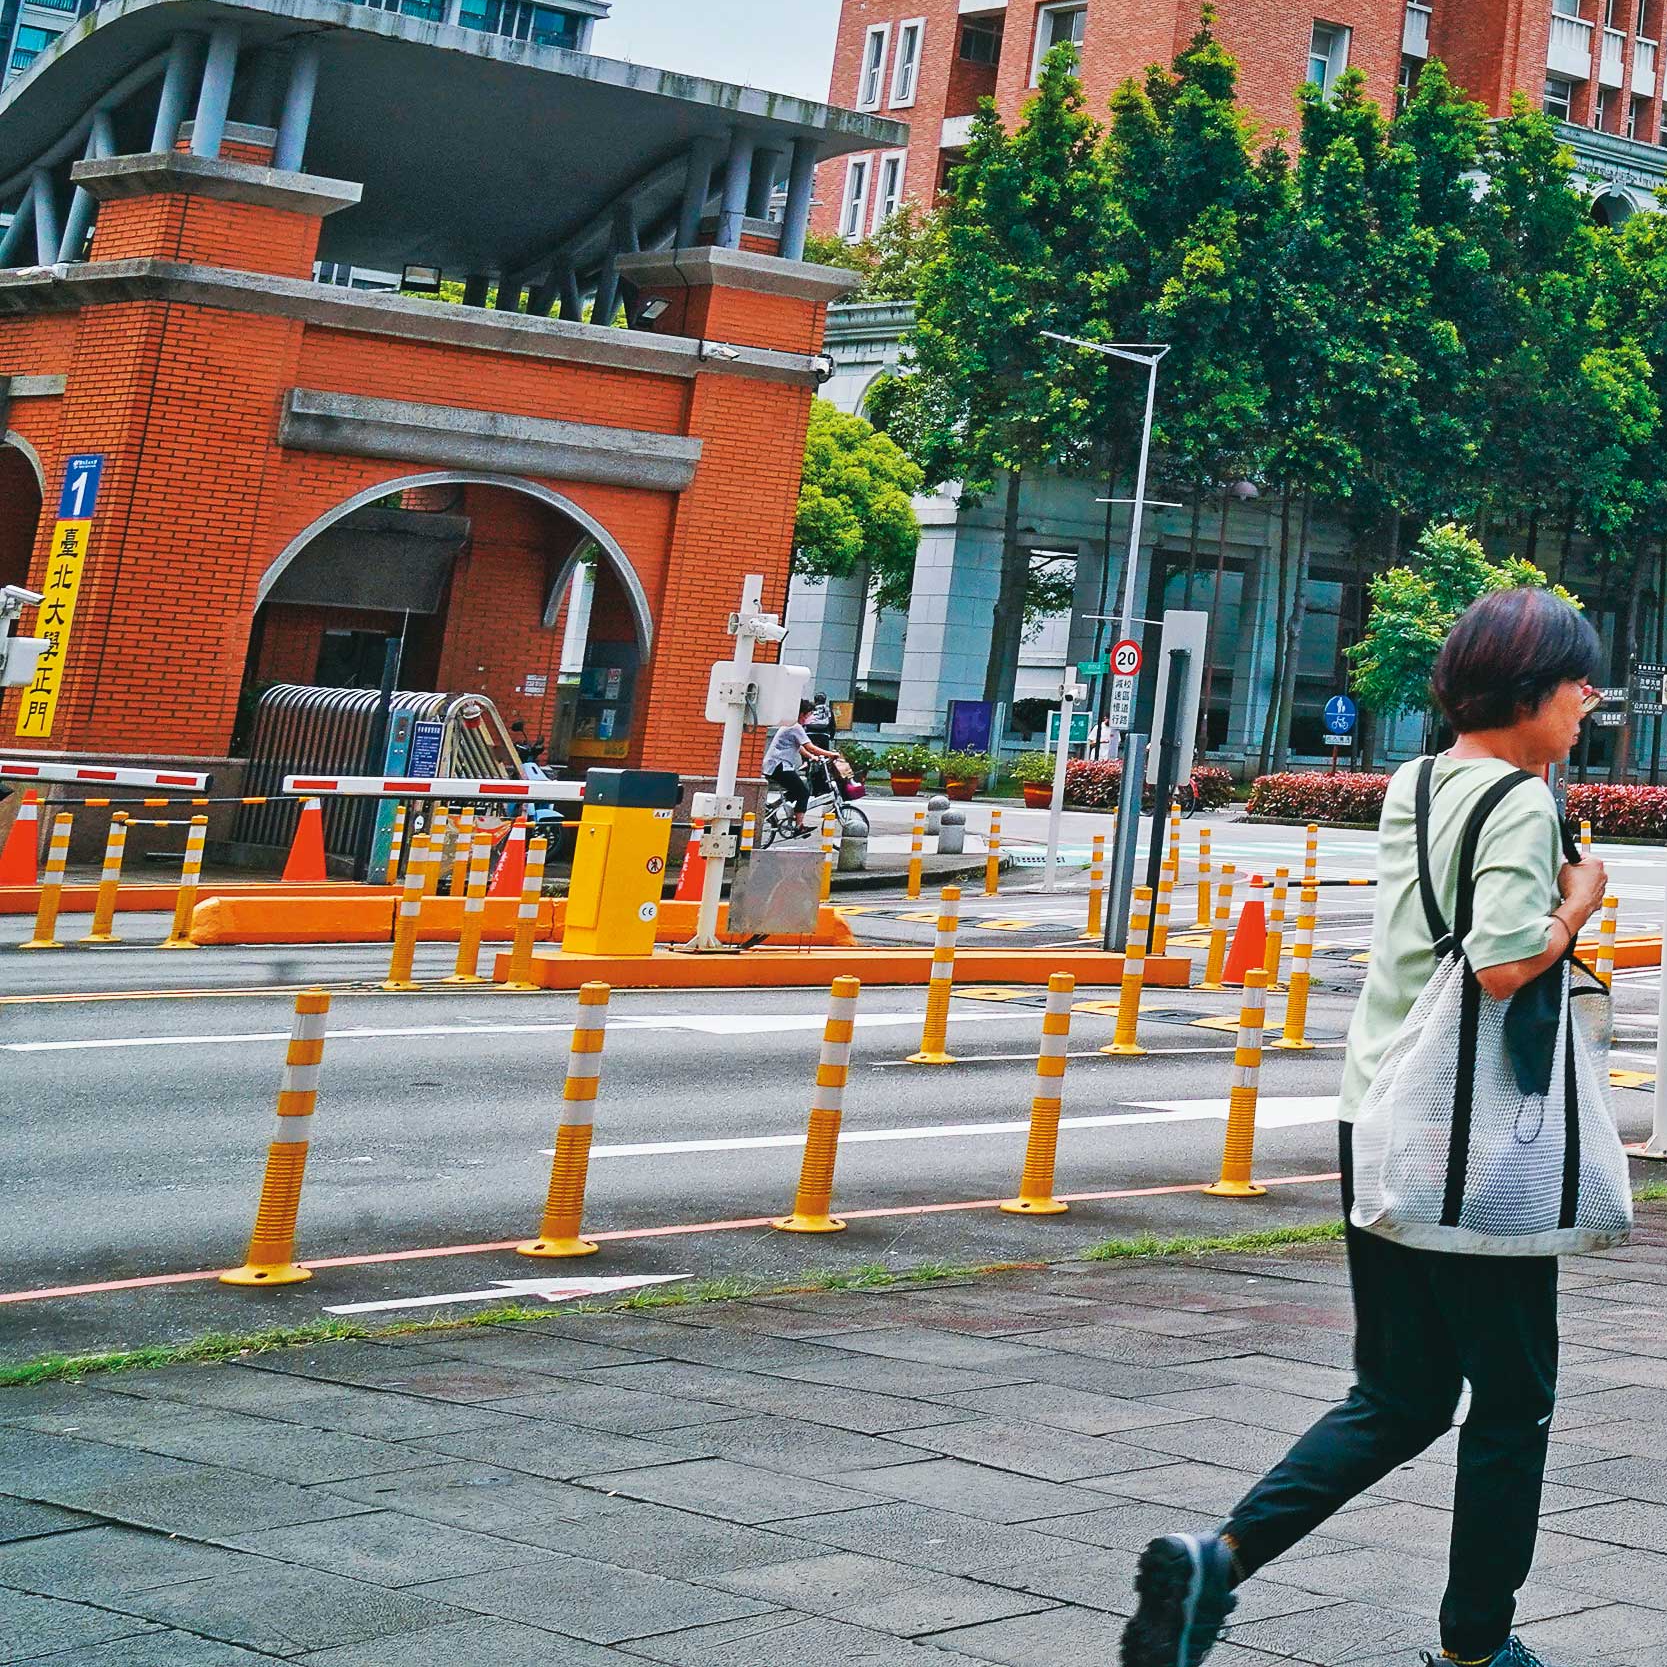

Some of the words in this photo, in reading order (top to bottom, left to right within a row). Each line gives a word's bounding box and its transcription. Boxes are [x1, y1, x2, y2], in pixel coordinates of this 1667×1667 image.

[71, 472, 88, 515] 1
[23, 528, 79, 731] 臺北大學正門
[1117, 652, 1136, 666] 20
[641, 906, 654, 916] CE
